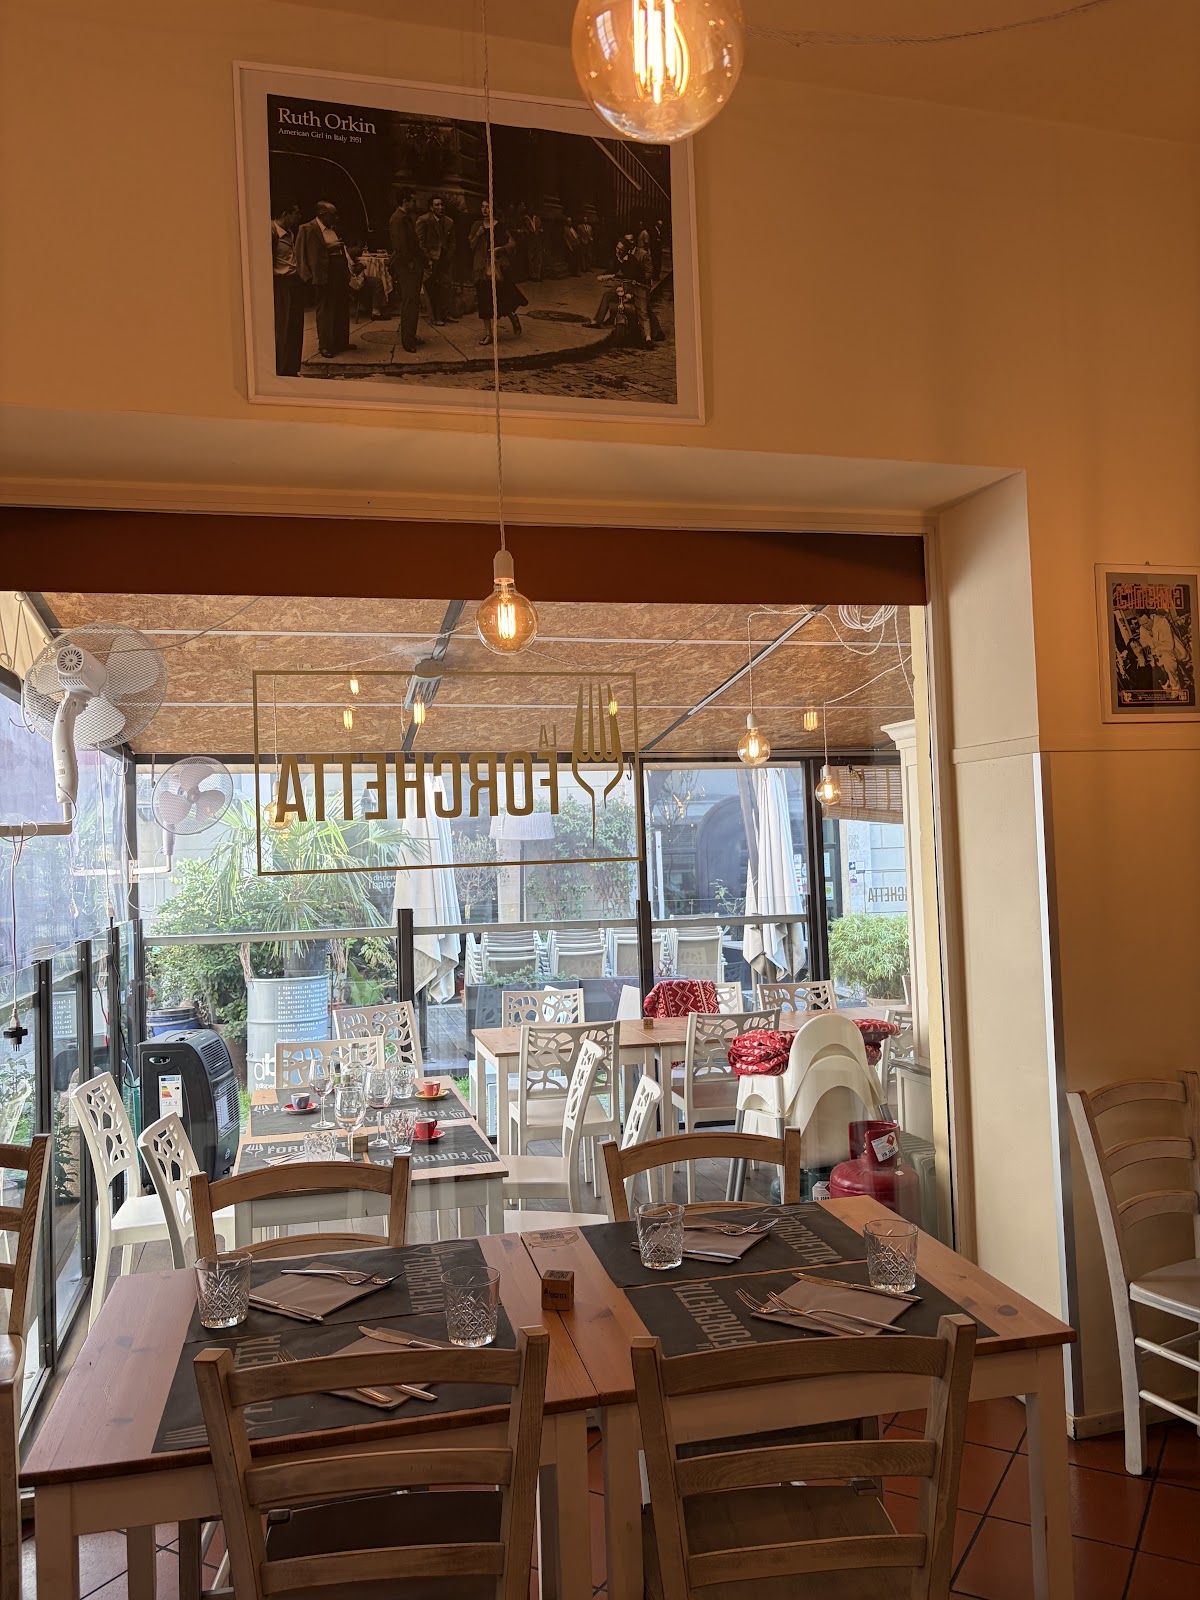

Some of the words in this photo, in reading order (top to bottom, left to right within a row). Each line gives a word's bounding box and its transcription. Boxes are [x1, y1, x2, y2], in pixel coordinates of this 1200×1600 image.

[277, 107, 322, 128] Ruth
[324, 113, 377, 135] Orkin
[278, 128, 310, 138] American
[310, 131, 324, 139] Girl
[325, 132, 333, 140] in
[333, 133, 348, 143] Italy
[349, 135, 362, 143] 1951
[374, 1151, 469, 1167] FORCHTA
[762, 1215, 844, 1265] FORCHETTA
[403, 1255, 445, 1312] FORCHETTA
[672, 1282, 758, 1349] FORCHETTA
